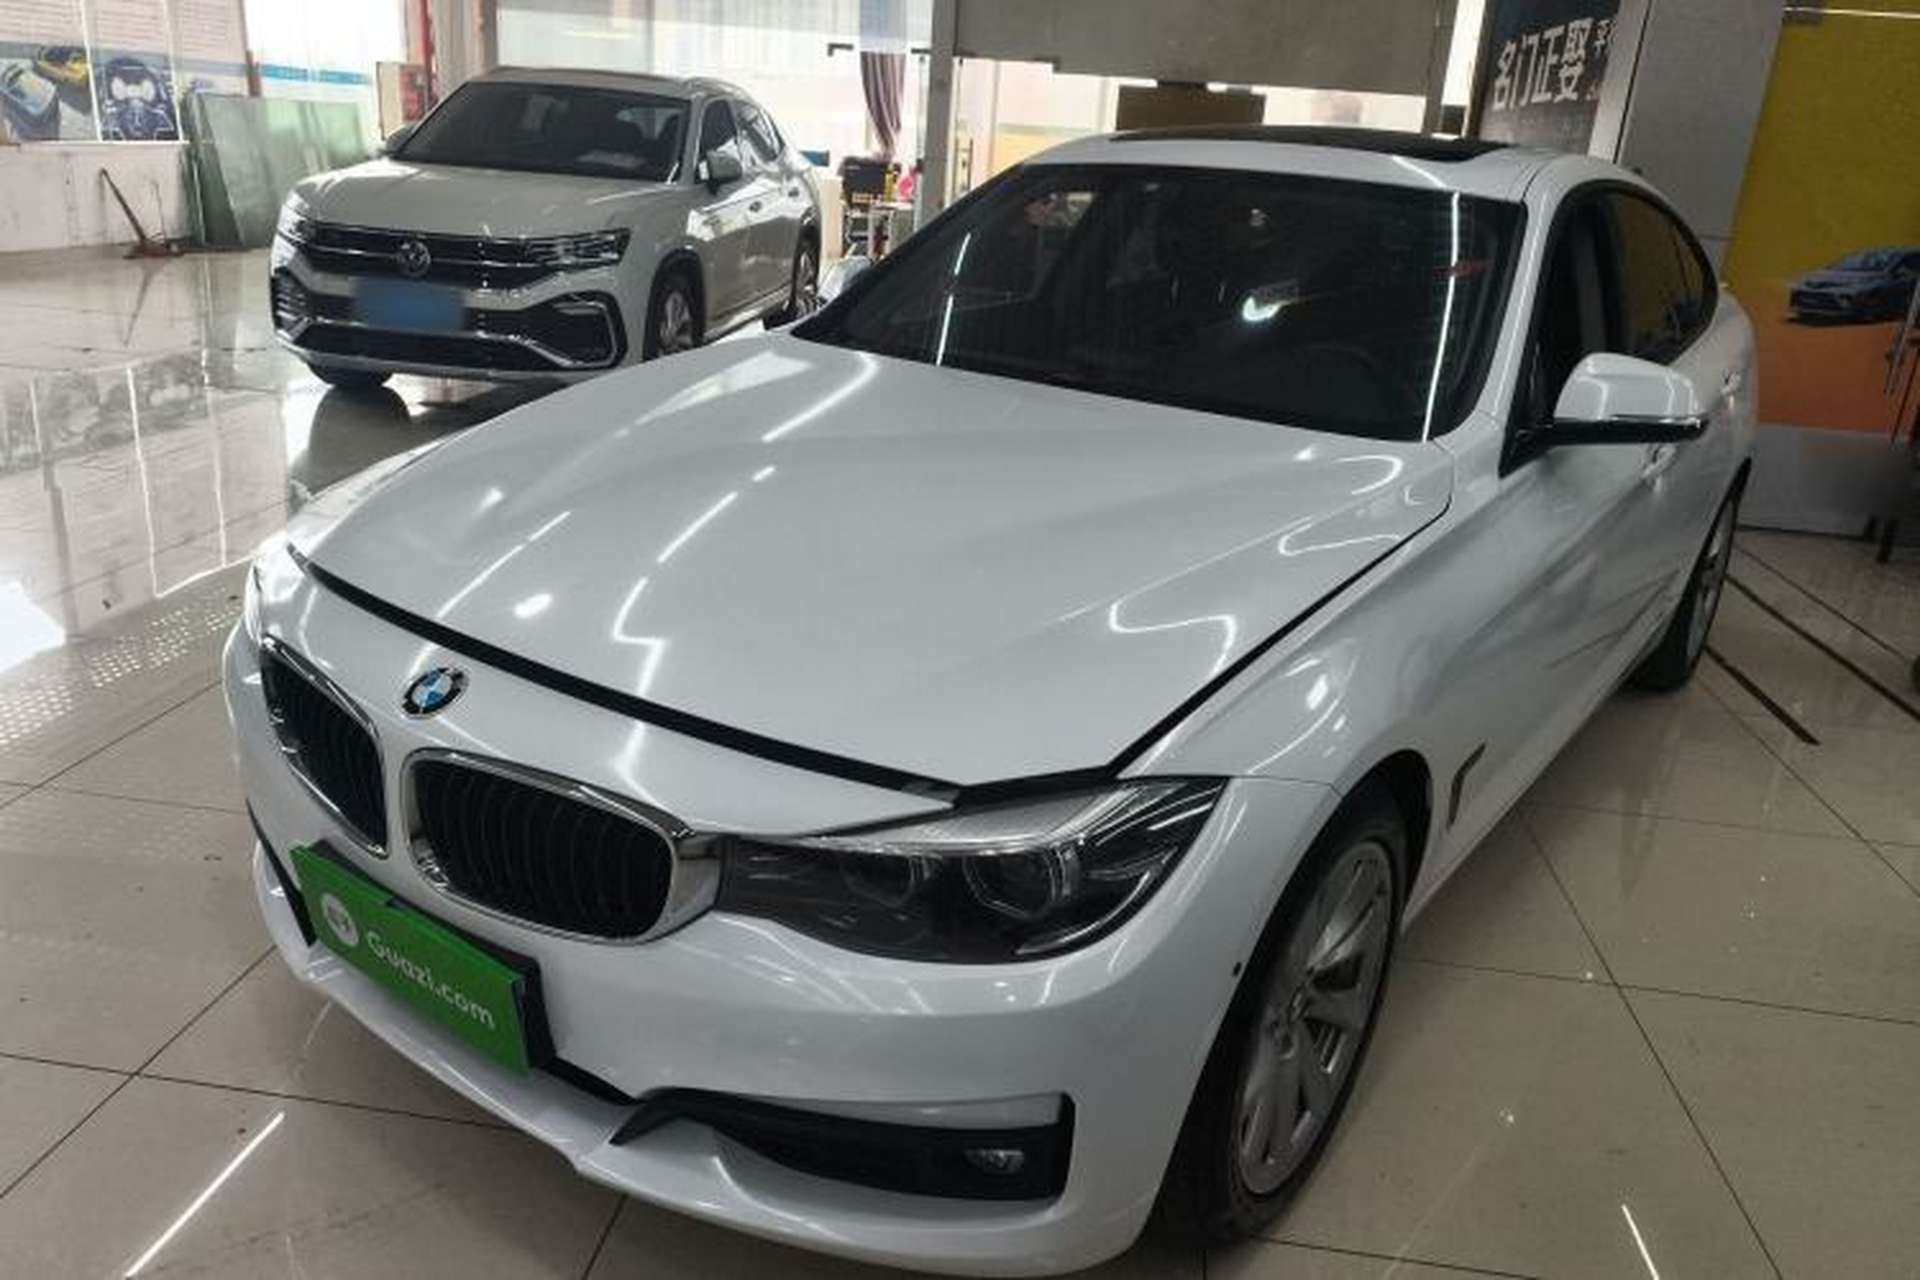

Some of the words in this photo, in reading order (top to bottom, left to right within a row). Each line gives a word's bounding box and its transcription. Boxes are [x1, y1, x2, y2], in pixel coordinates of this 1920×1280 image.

[1493, 17, 1593, 110] 名门正娶
[366, 931, 495, 1031] Guazi.com
